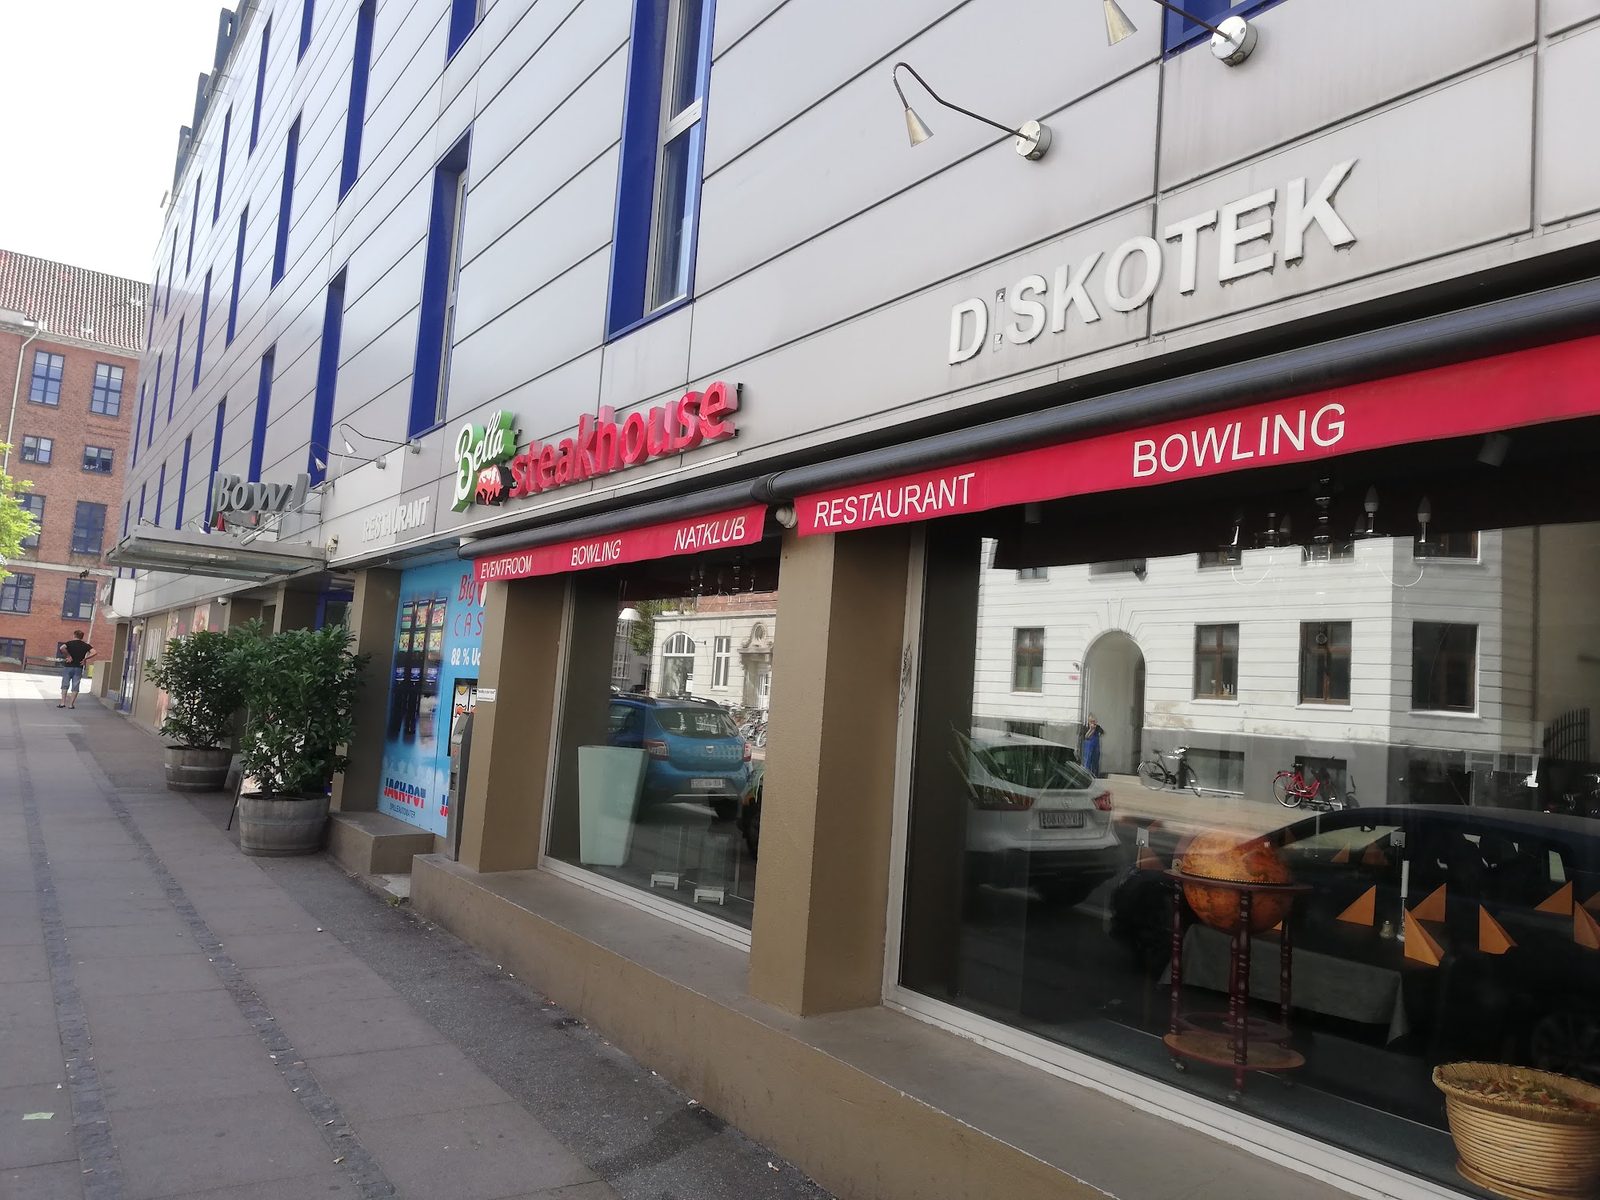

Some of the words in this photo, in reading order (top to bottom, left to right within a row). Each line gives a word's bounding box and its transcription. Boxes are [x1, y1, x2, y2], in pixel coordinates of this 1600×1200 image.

[947, 157, 1359, 367] DSKOTEK
[451, 409, 512, 512] Bella
[508, 380, 738, 498] steakhouse
[813, 472, 976, 529] RESTAURANT
[1132, 402, 1347, 479] BOWLING
[458, 574, 476, 607] Big
[480, 554, 533, 579] EVENTROOM
[570, 540, 622, 567] BOWLING
[673, 515, 746, 551] NATKLUB
[451, 647, 461, 666] 82
